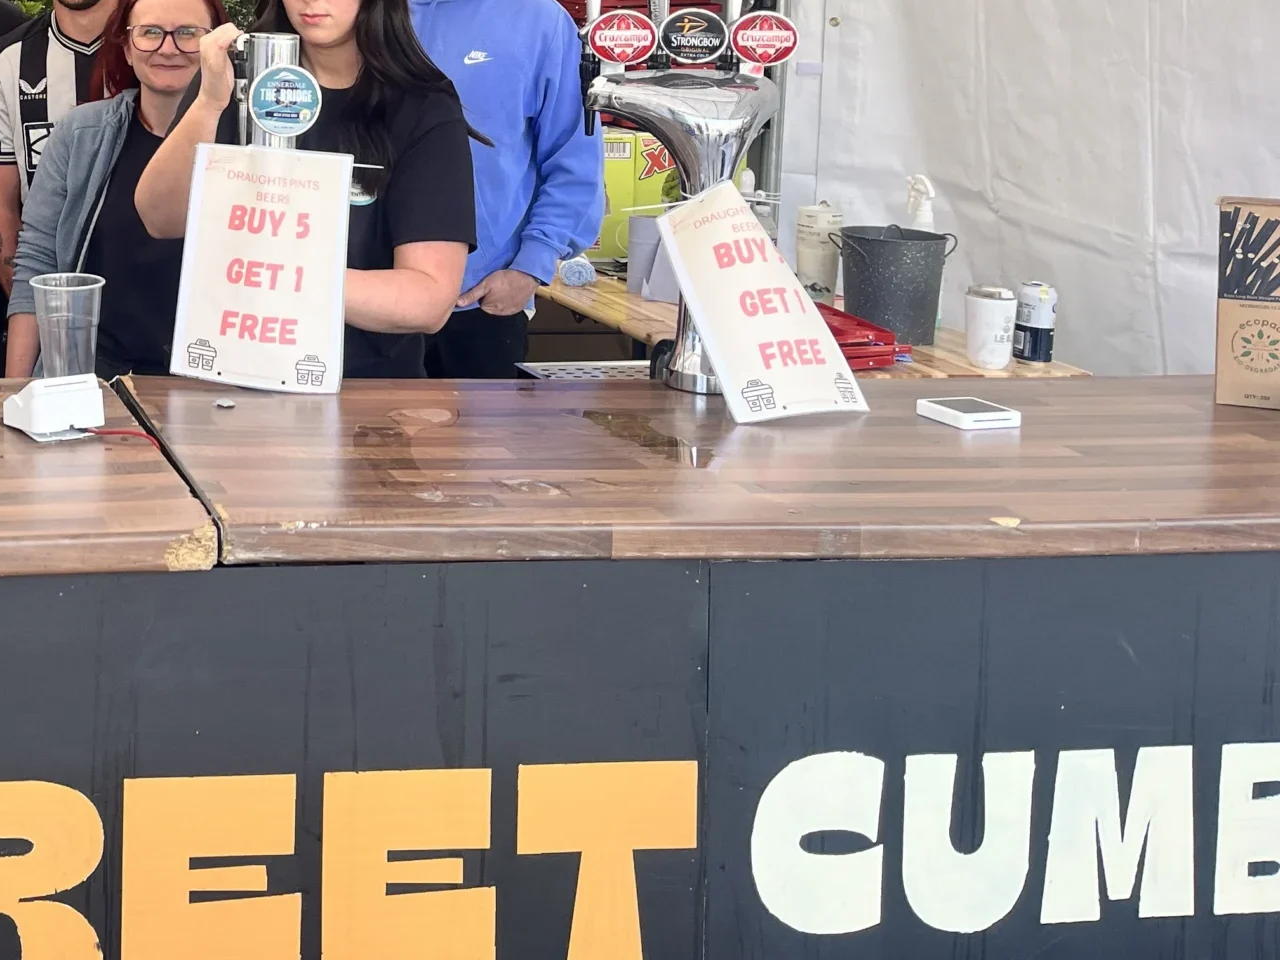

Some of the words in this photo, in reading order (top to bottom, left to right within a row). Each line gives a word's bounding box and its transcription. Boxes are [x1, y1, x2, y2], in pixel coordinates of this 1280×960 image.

[598, 32, 649, 44] Cruzcampo
[671, 34, 721, 47] STRONGBOW
[741, 32, 791, 44] Cruzcampo
[267, 81, 307, 89] ENNERDALE
[20, 93, 47, 101] CASTORE
[260, 87, 277, 102] THE
[278, 88, 313, 103] BRIDGE
[226, 169, 289, 189] DRAUGHTS
[288, 178, 320, 191] PINTS
[255, 190, 291, 205] BEERS
[227, 204, 287, 238] BUY
[295, 212, 311, 240] 5
[712, 236, 769, 270] BUY
[226, 257, 284, 291] GET
[294, 266, 304, 293] 1
[739, 287, 790, 318] GET
[218, 309, 299, 346] FREE
[758, 338, 827, 371] FREE
